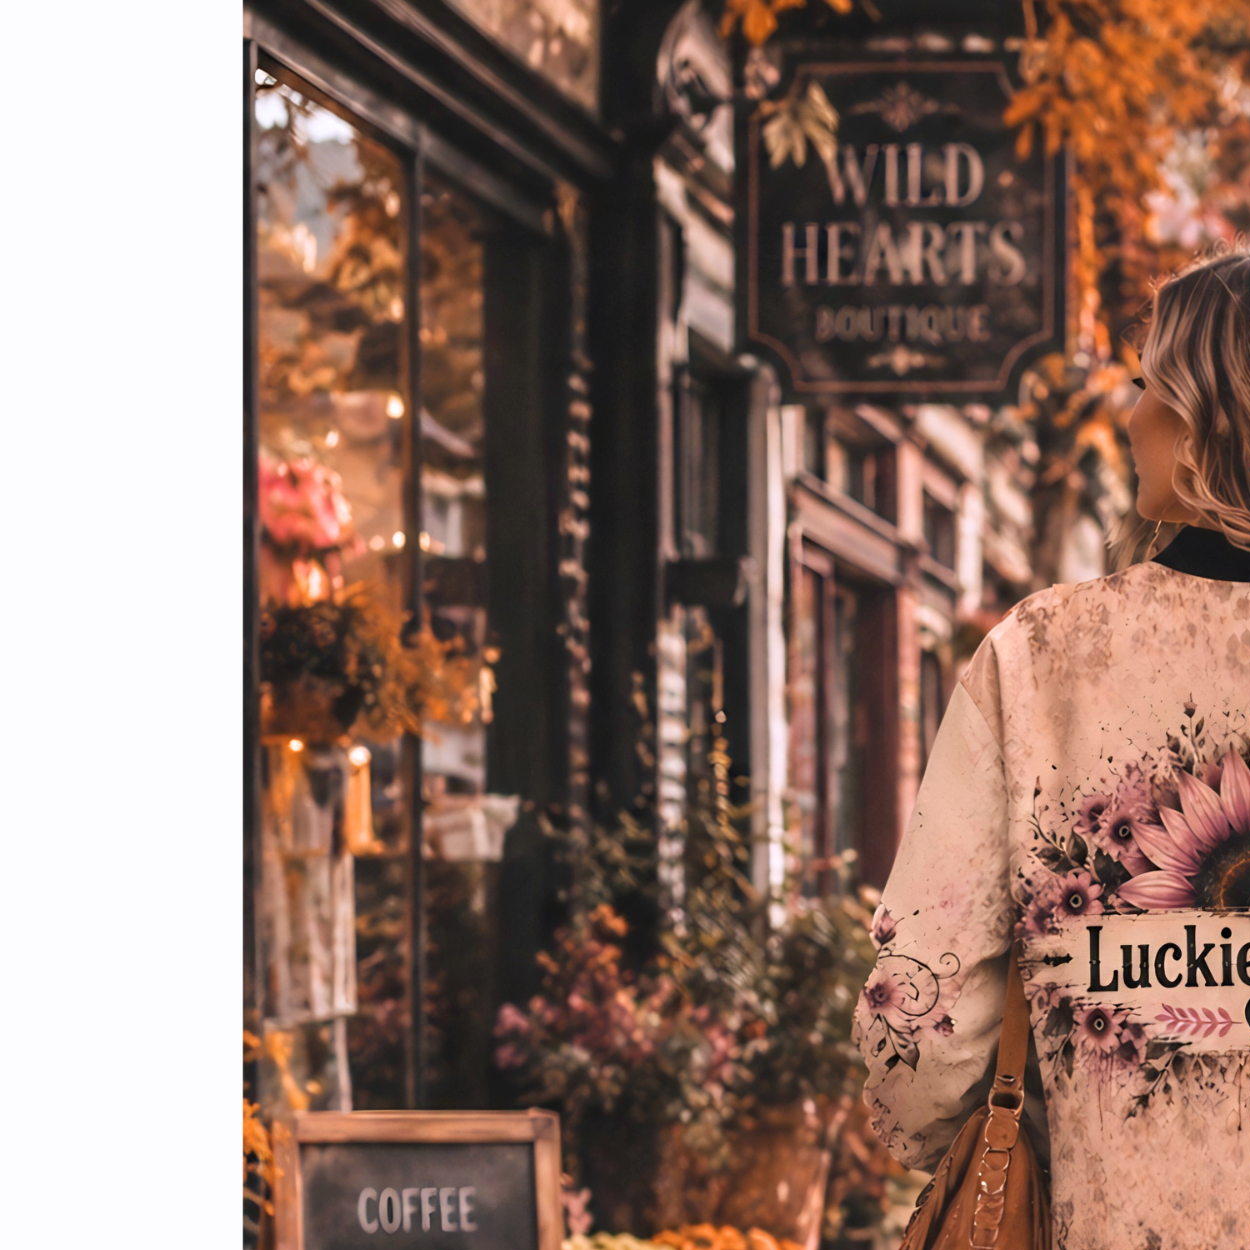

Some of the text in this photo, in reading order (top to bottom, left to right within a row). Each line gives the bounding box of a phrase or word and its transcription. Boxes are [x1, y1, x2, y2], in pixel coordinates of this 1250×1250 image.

[827, 142, 985, 207] WILD
[781, 220, 1026, 287] HEARTS
[814, 304, 991, 344] BOUTIQUE
[357, 1186, 478, 1235] COFFEE
